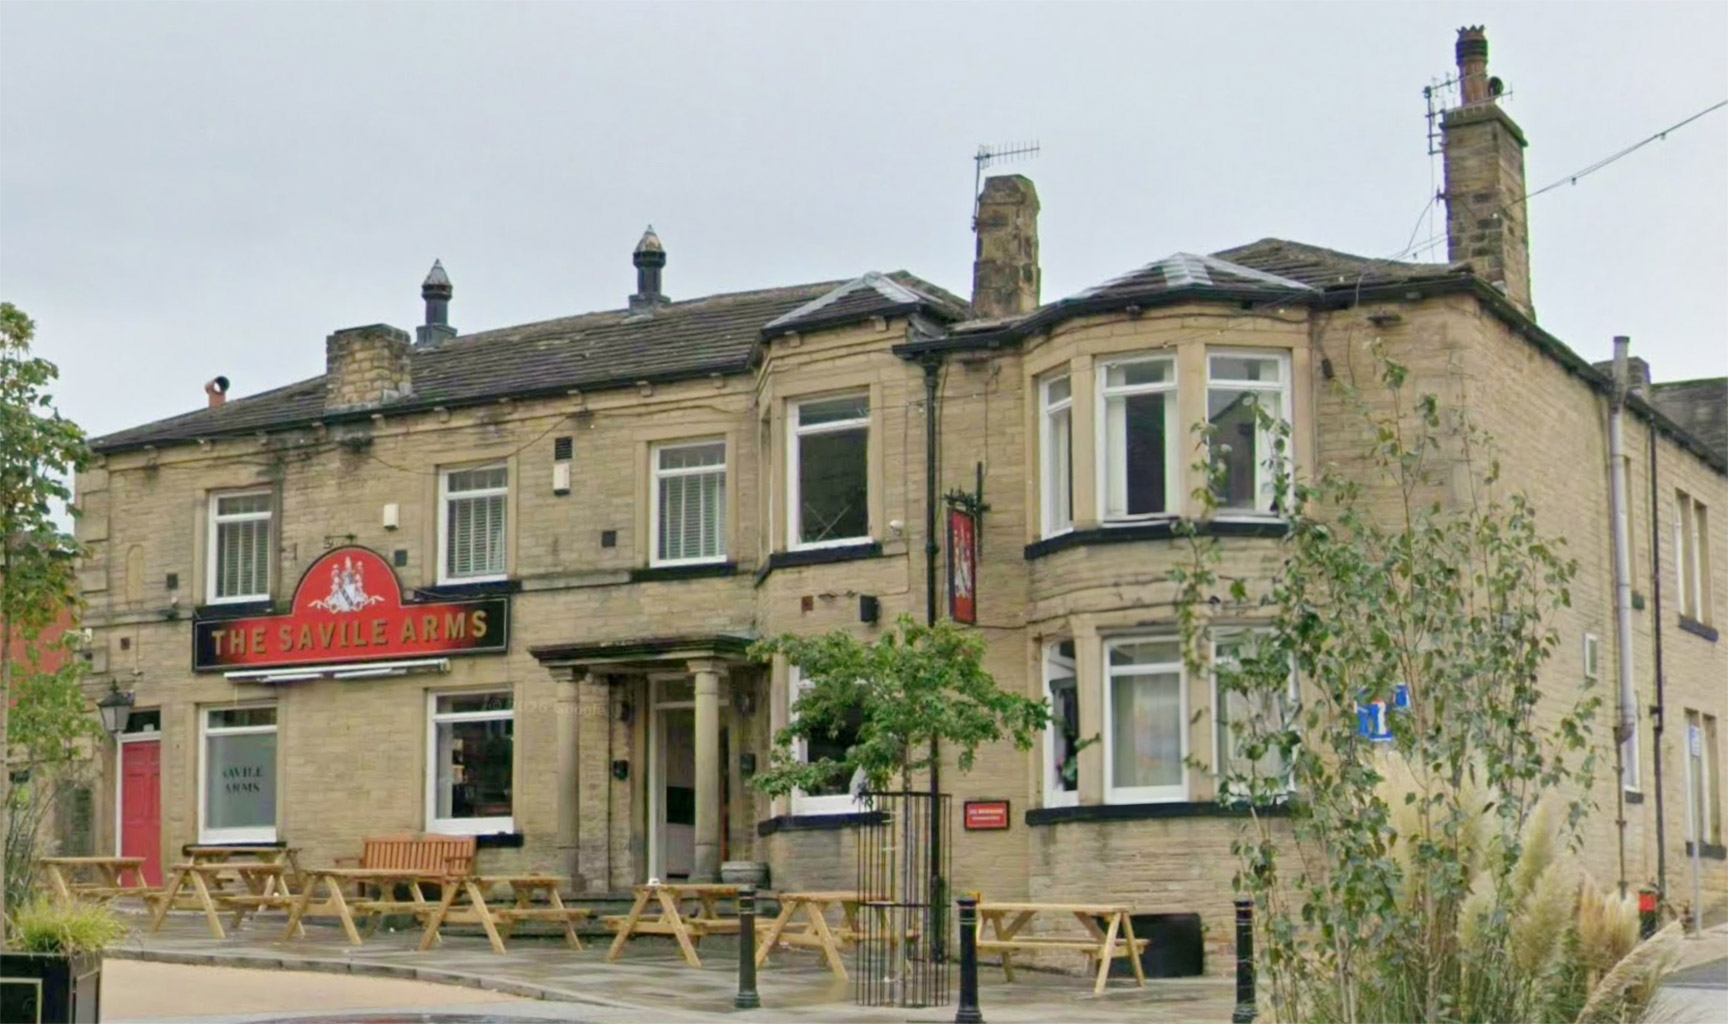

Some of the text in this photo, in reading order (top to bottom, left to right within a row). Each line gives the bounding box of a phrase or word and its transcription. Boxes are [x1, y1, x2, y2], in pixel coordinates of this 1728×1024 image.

[211, 610, 489, 657] THE SAVILE ARMS
